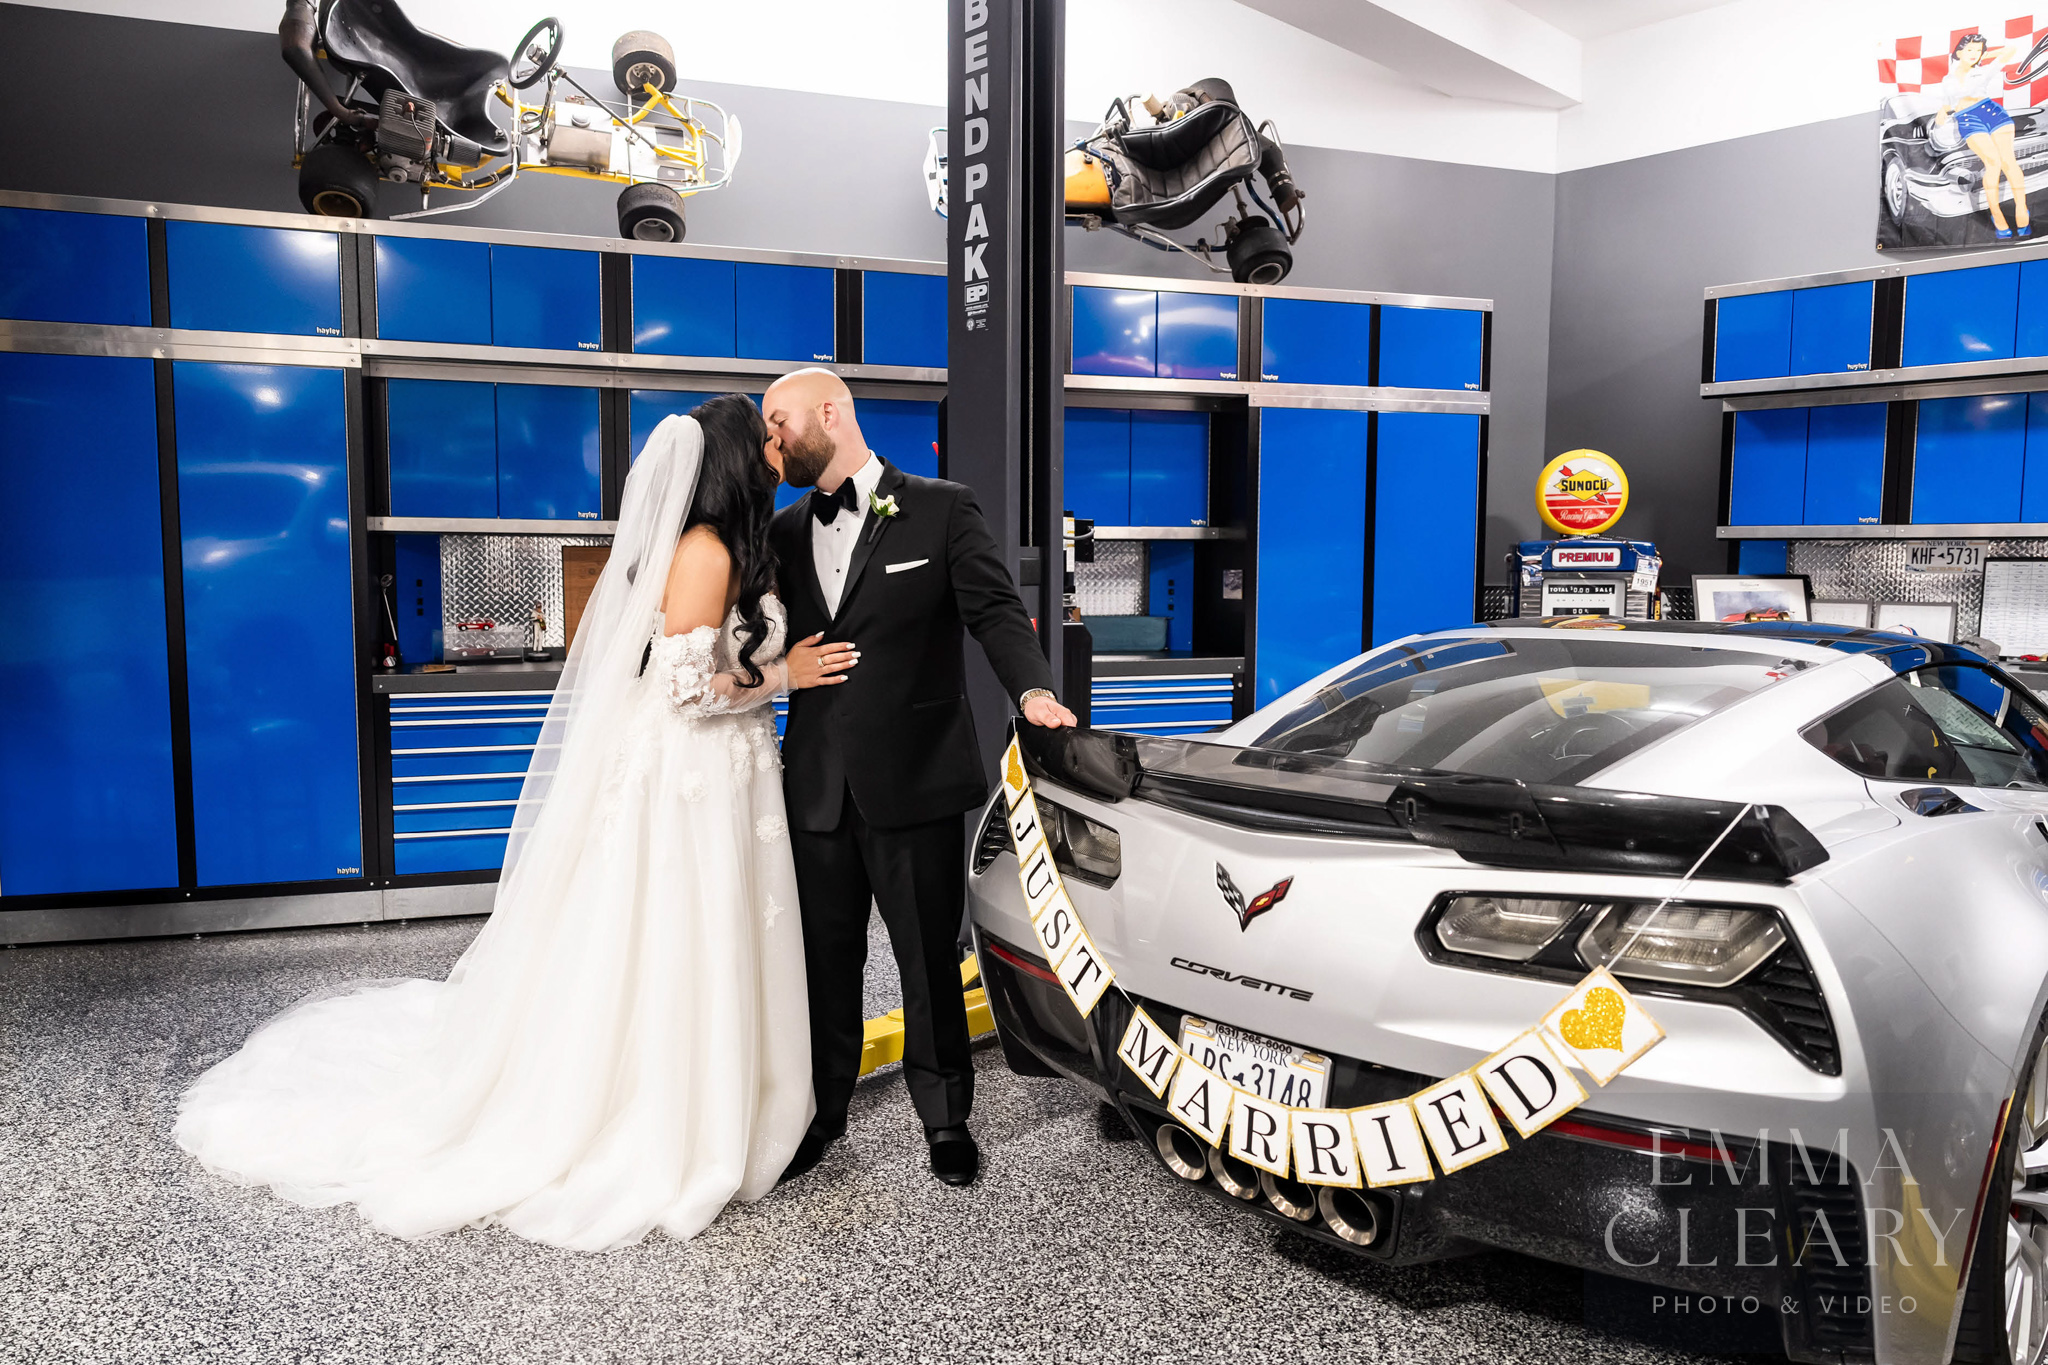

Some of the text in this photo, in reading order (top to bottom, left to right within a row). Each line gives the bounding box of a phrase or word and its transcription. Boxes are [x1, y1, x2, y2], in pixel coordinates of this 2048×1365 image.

[964, 0, 989, 282] BENDPAK
[316, 326, 340, 336] hayley
[578, 341, 600, 350] hayley
[1561, 479, 1607, 491] SUNOCO
[1558, 552, 1614, 563] PREMIUM
[1911, 547, 1979, 565] KHF 5731
[336, 866, 360, 875] hayley
[1015, 815, 1102, 996] JUST
[1170, 957, 1314, 1002] CORVETTE
[1215, 1023, 1293, 1054] (631) 265-6000
[1216, 1034, 1290, 1068] NEW YORK
[1123, 1018, 1559, 1176] MARRIED
